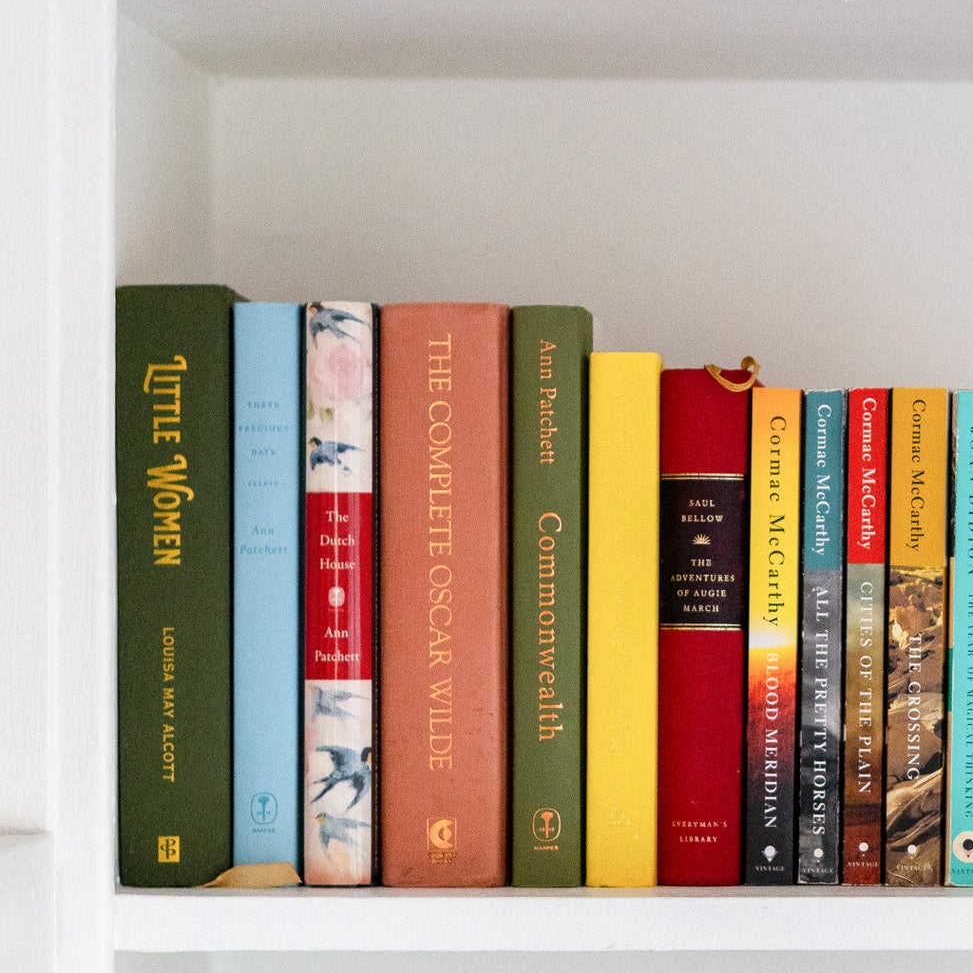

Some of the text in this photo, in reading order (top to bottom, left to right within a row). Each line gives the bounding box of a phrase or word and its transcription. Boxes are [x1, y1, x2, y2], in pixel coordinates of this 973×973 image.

[540, 339, 558, 465] Ann Patchett
[688, 499, 715, 507] SAUL
[812, 404, 832, 556] Cormac McCarthy
[857, 398, 877, 550] Cormac McCarthy
[906, 399, 927, 552] Cormac McCarthy
[319, 533, 355, 546] Dutch
[325, 510, 349, 523] The
[681, 514, 724, 522] BELLOW
[763, 415, 787, 626] Cormac McCarthy
[319, 557, 356, 570] House
[428, 332, 453, 771] THE COMPLETE OSCAR WILDE
[670, 574, 735, 582] ADVENTURES
[690, 558, 712, 567] THE
[676, 589, 727, 597] OF AUGIE
[683, 604, 720, 612] MARCH
[314, 649, 360, 662] Patchett
[324, 626, 349, 638] Ann
[538, 512, 564, 741] Commonwealth
[162, 626, 175, 783] LOUISA MAY ALCOTT
[813, 586, 829, 836] ALL THE PRETTY HORSES
[858, 581, 874, 794] CITIES OF THE PLAIN
[907, 633, 922, 780] THE CROSSING
[764, 652, 779, 829] BLOOD MERIDIAN
[965, 754, 973, 819] THINKING
[679, 835, 718, 843] LIBRARY
